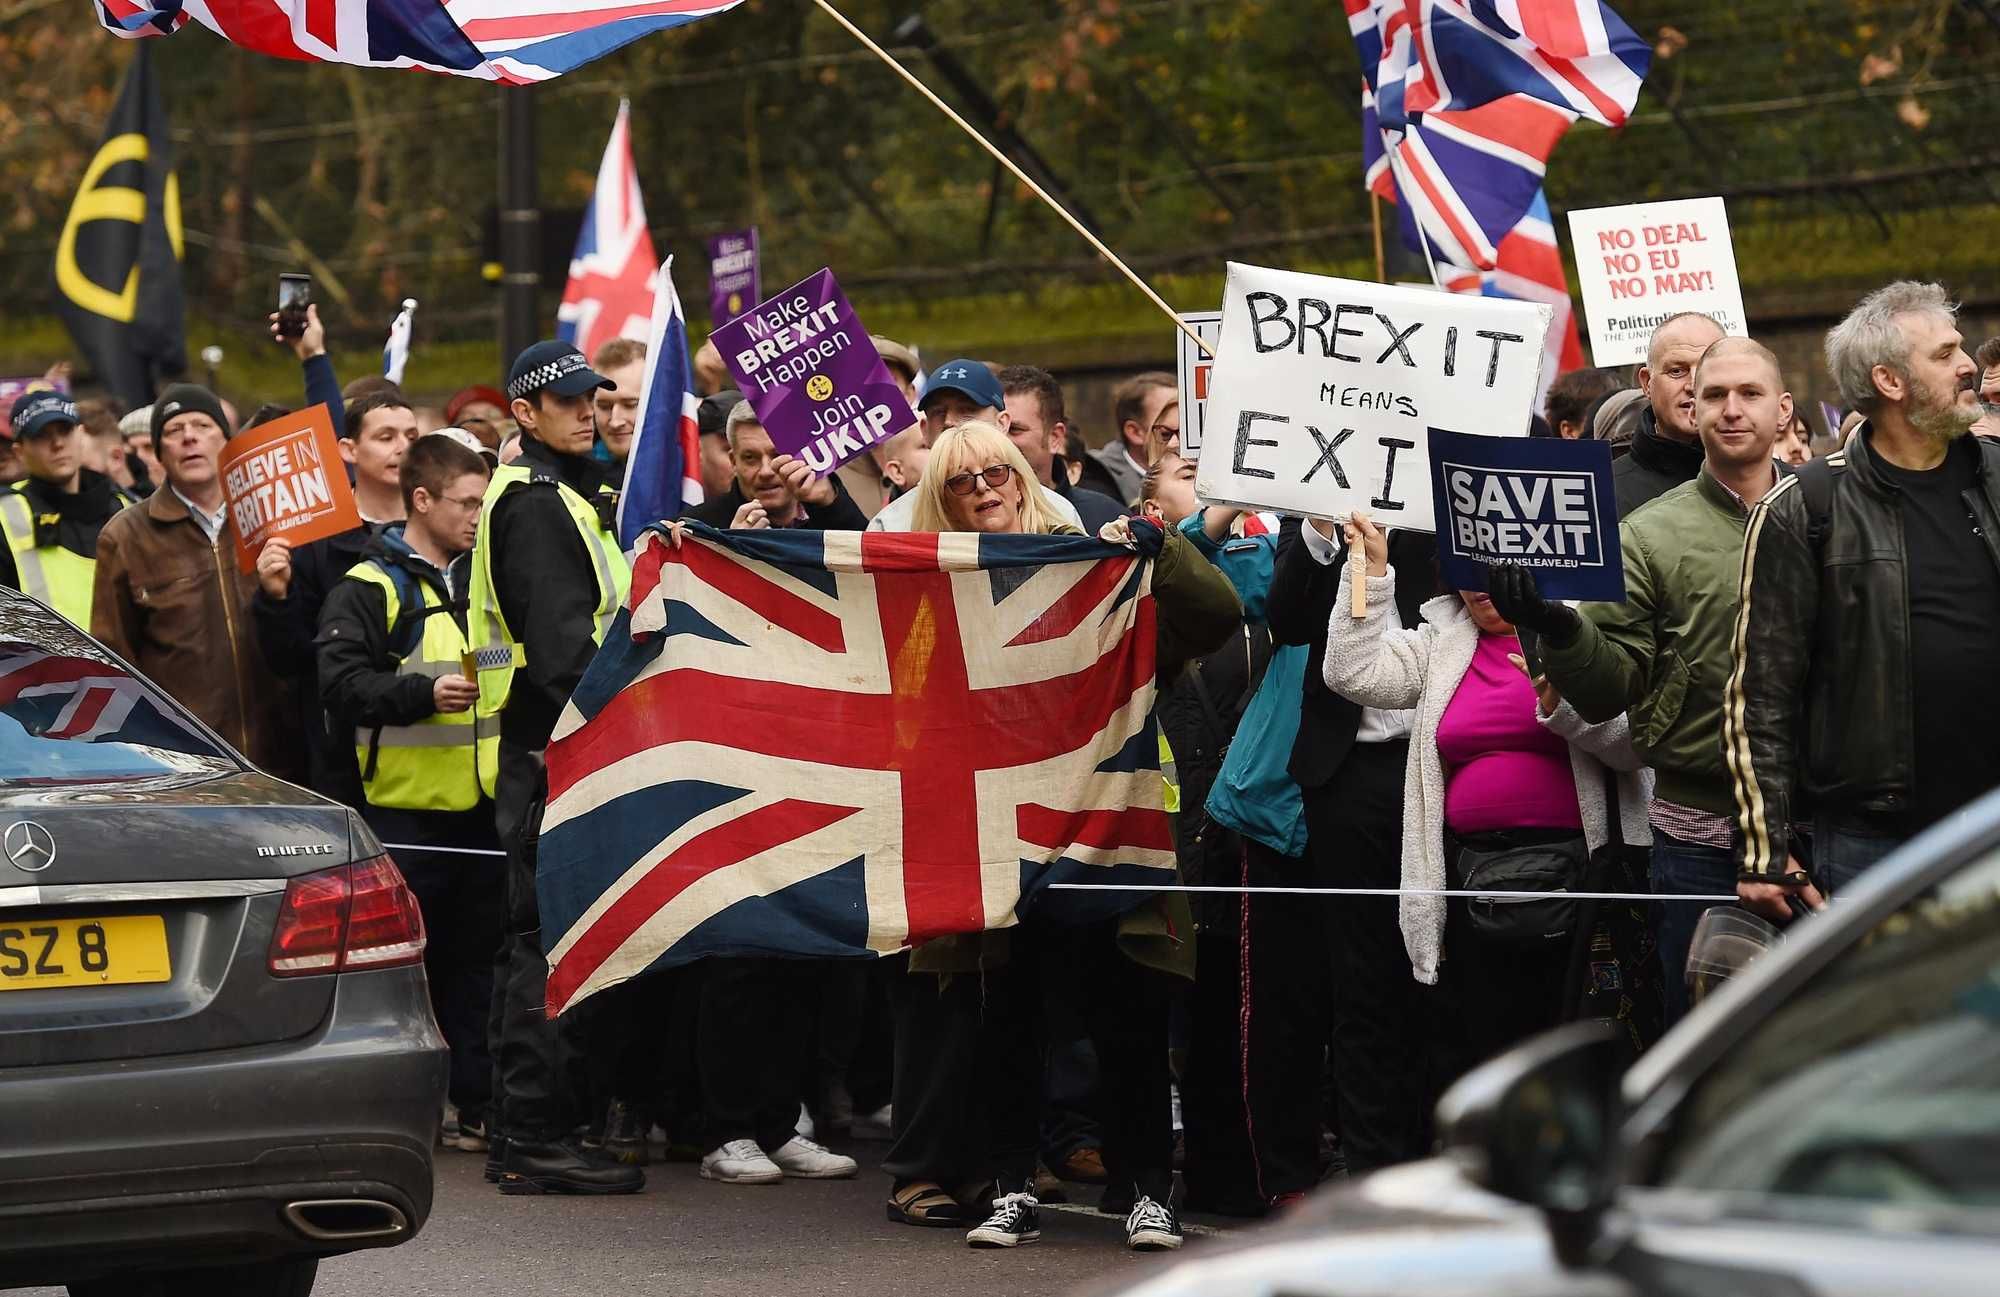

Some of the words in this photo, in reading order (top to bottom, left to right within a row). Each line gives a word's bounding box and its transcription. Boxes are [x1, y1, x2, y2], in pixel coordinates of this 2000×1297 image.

[1598, 229, 1635, 250] NO
[1642, 222, 1707, 247] DEAL
[1603, 253, 1641, 275] NO
[1648, 249, 1680, 270] EU
[1609, 277, 1647, 300] NO
[1654, 271, 1715, 296] MAY!
[736, 301, 840, 375] BREXIT
[743, 295, 811, 342] Make
[1246, 291, 1524, 388] BREXIT
[755, 331, 851, 394] Happen
[810, 395, 865, 436] Join
[1320, 383, 1418, 417] MEANS
[801, 404, 892, 472] UKIP
[1232, 410, 1416, 511] EXI
[226, 446, 292, 499] BELIEVE
[292, 436, 319, 468] IN
[233, 467, 330, 540] BRITAIN
[1451, 470, 1590, 521] SAVE
[1456, 515, 1592, 556] BREXIT
[257, 844, 332, 857] BLUETEC
[77, 924, 109, 972] 8
